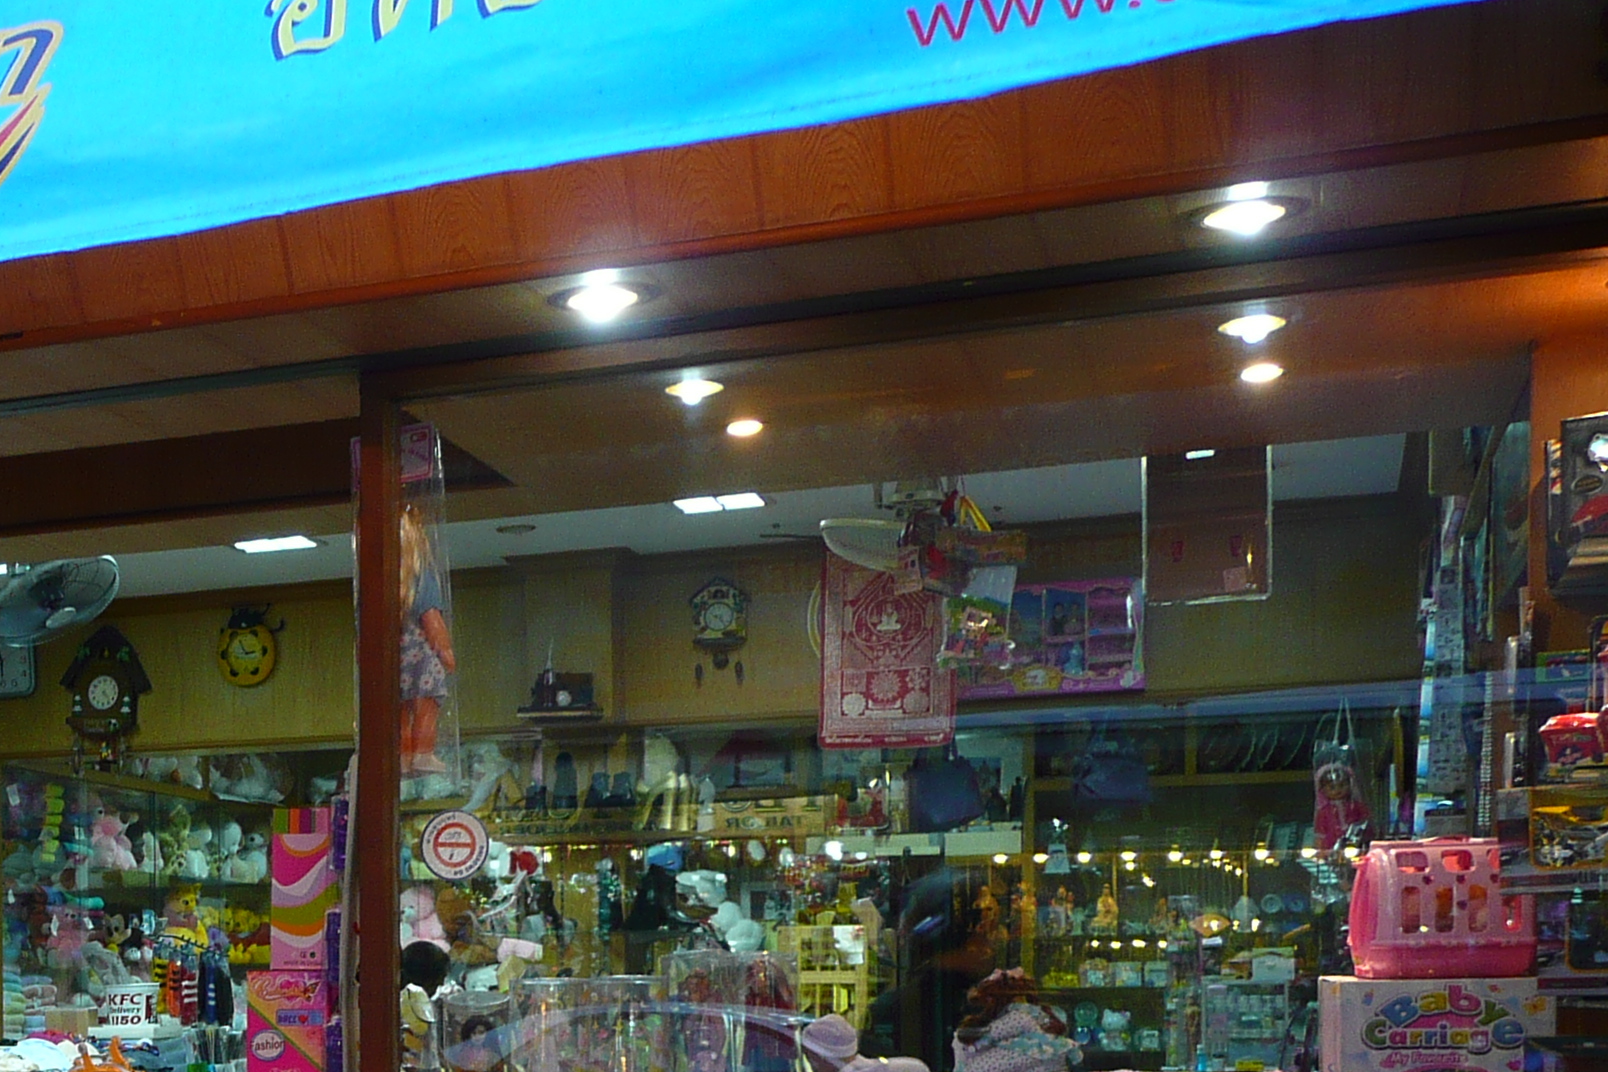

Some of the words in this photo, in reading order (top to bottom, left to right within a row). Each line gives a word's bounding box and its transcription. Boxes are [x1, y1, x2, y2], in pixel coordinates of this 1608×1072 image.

[108, 993, 142, 1006] KFC
[1379, 984, 1511, 1027] Baby
[1363, 1018, 1525, 1054] Carriage
